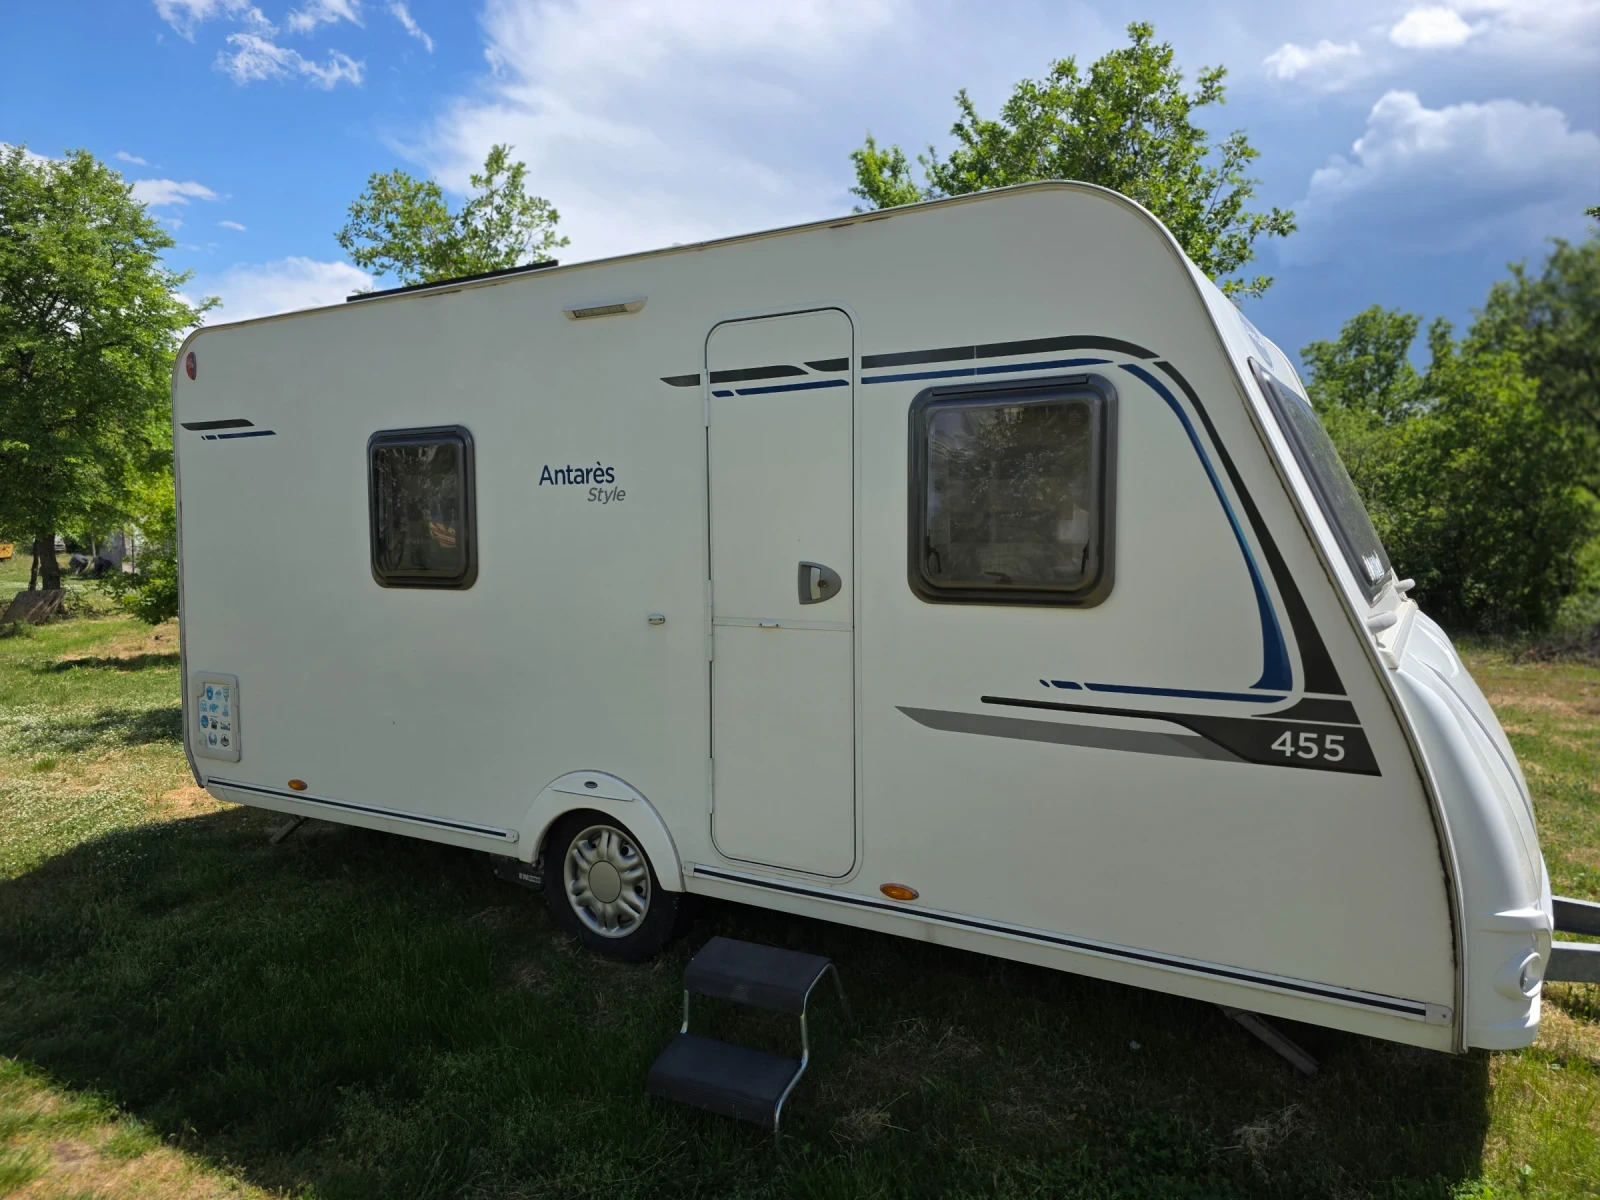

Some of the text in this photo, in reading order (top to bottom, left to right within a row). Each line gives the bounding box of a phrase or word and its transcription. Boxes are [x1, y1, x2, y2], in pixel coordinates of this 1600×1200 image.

[539, 461, 615, 486] Antarès
[587, 486, 626, 504] Style
[1270, 730, 1345, 762] 455
